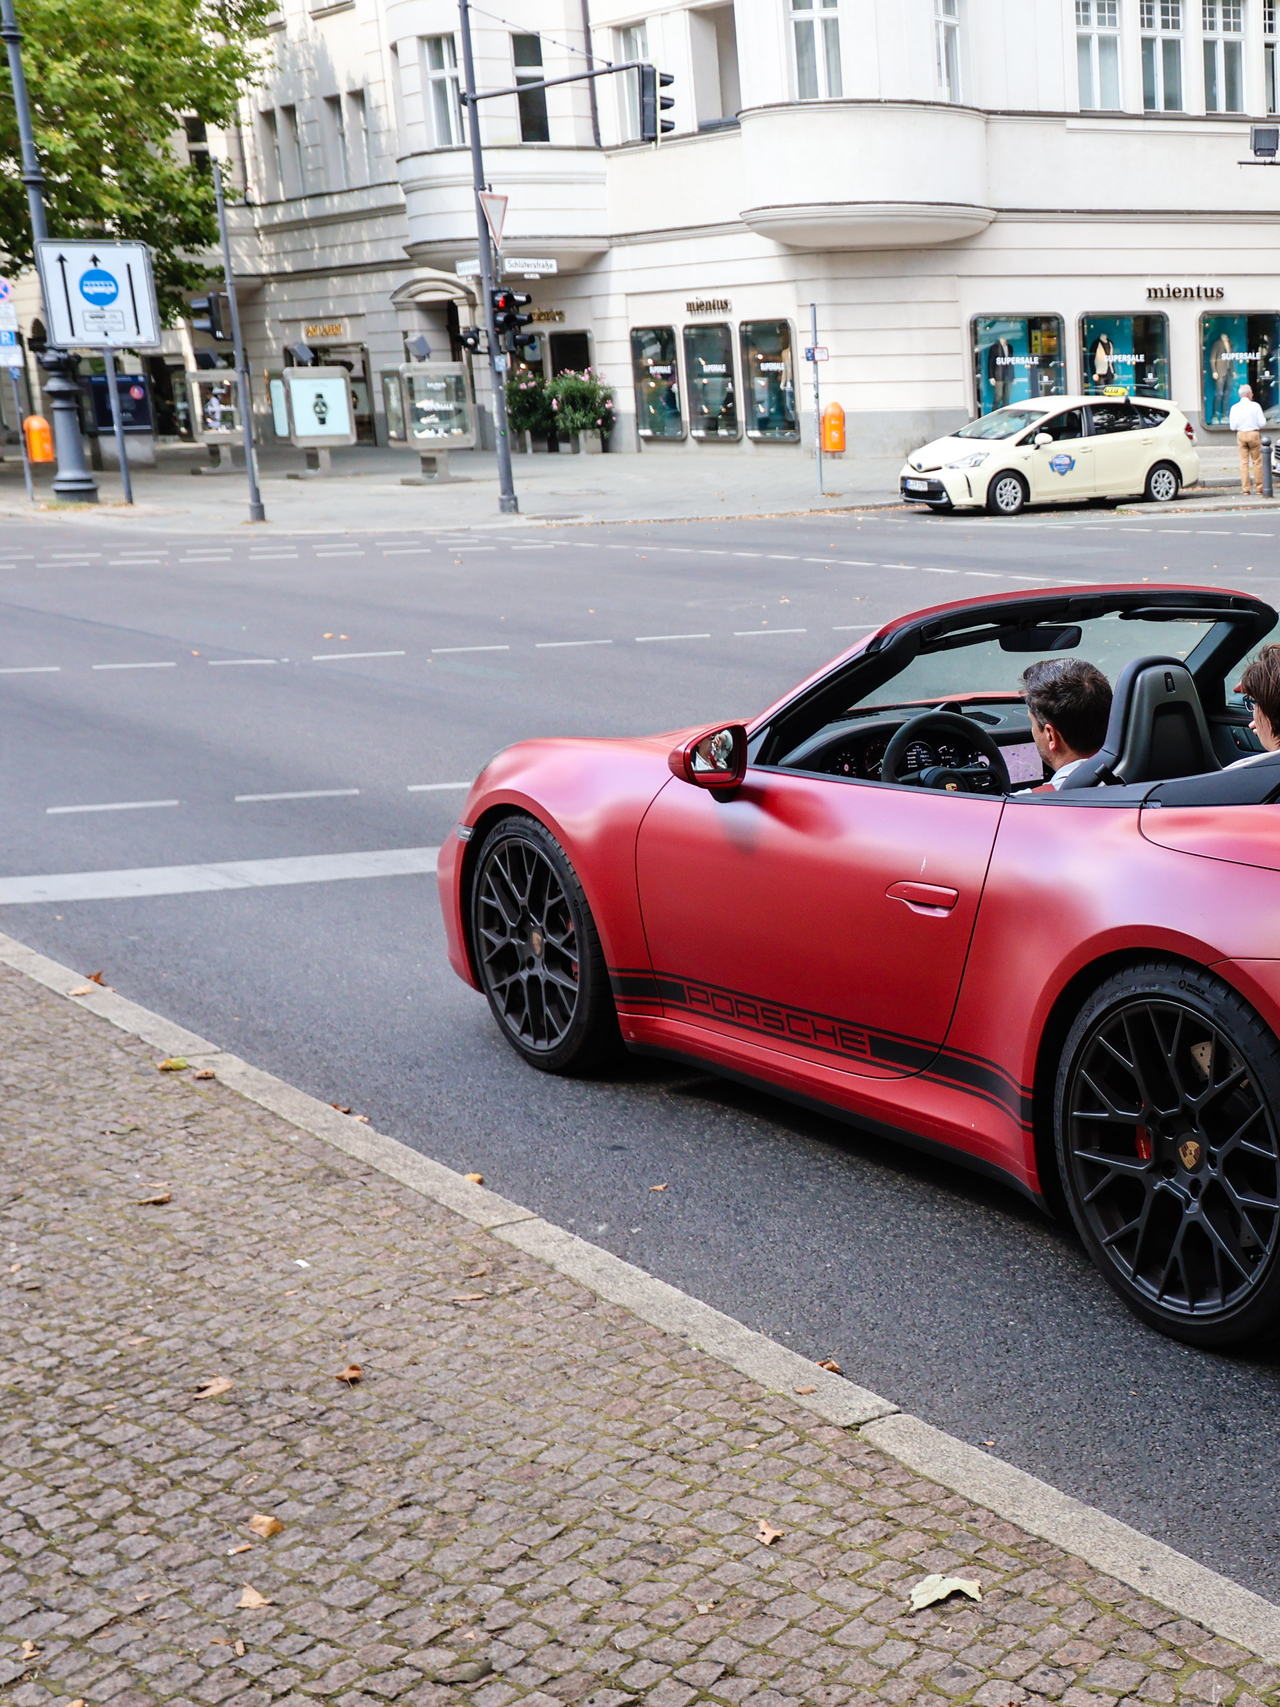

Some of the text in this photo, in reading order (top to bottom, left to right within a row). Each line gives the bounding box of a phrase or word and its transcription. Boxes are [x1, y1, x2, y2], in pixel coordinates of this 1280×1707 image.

[507, 259, 554, 271] Schlüterstraße
[1146, 283, 1224, 299] mientus
[686, 297, 729, 312] mientus
[996, 356, 1039, 366] SUPERSALE
[1103, 354, 1145, 363] SUPERSALE
[1221, 352, 1261, 361] SUPERSALE
[649, 365, 672, 374] SUPERSALE
[703, 363, 727, 373] SUPERSALE
[760, 362, 785, 372] SUPERSALE
[687, 985, 868, 1055] PORSCHE
